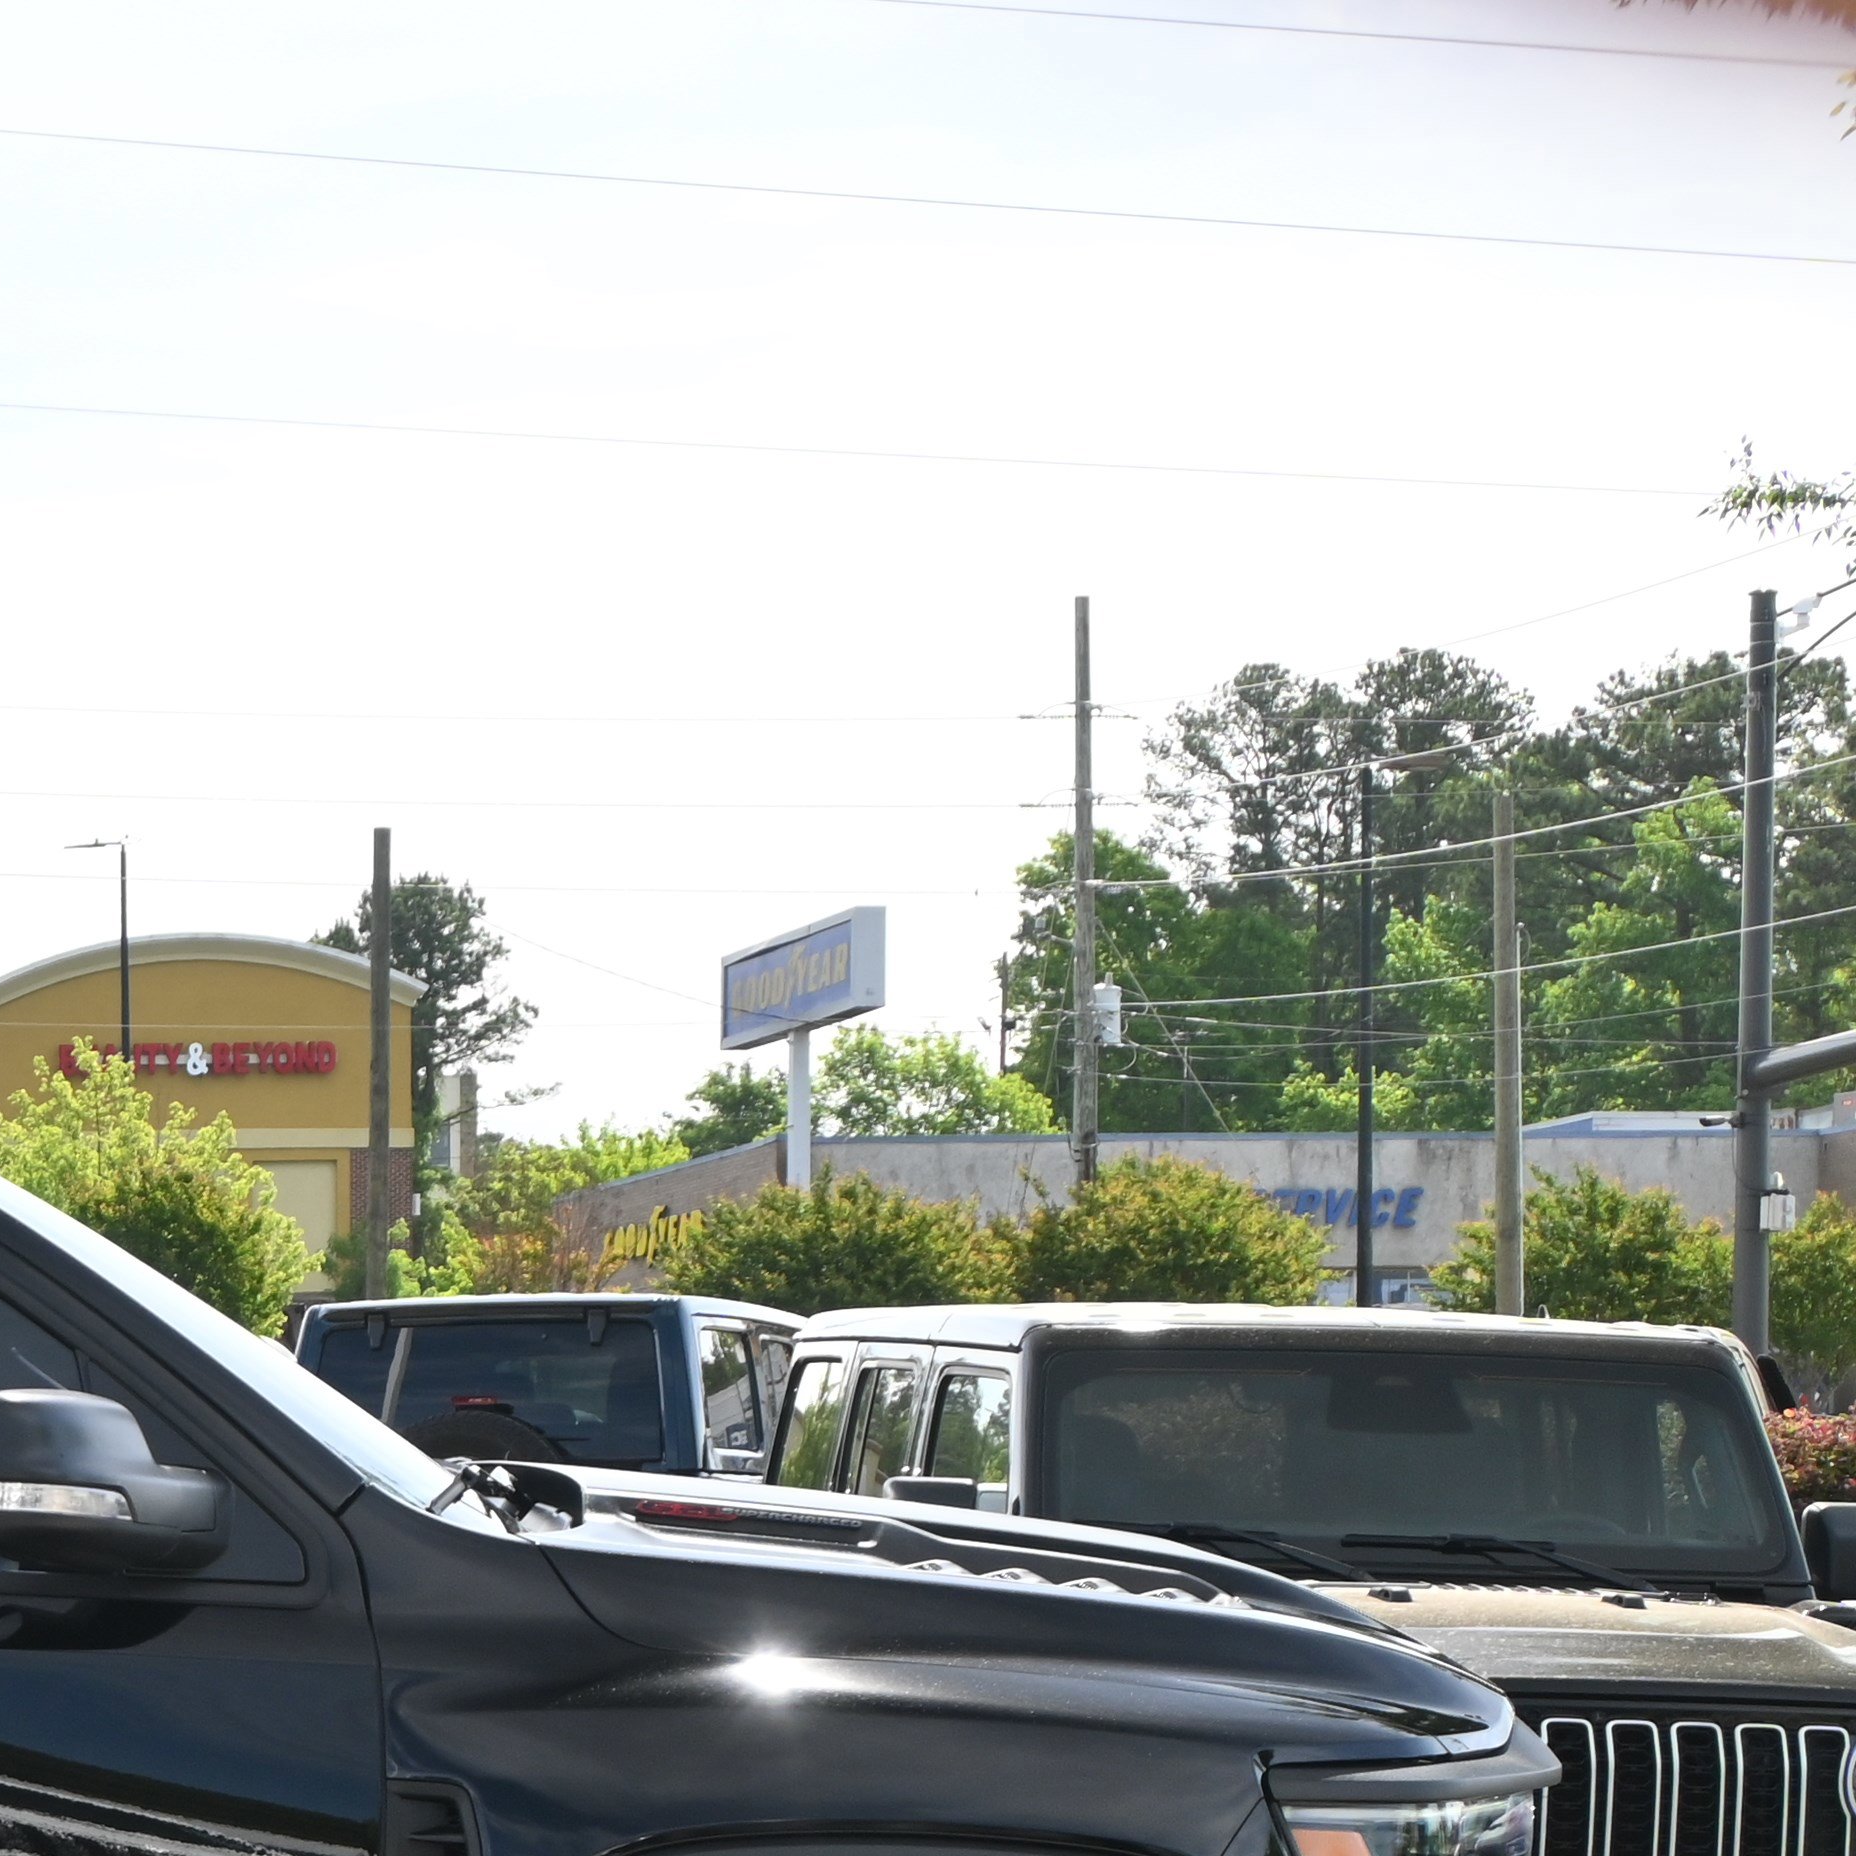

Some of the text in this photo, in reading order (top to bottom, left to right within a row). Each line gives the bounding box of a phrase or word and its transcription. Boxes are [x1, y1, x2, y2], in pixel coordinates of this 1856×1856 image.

[59, 1040, 338, 1076] BTY & BEYOND
[1255, 1186, 1425, 1229] RVCE
